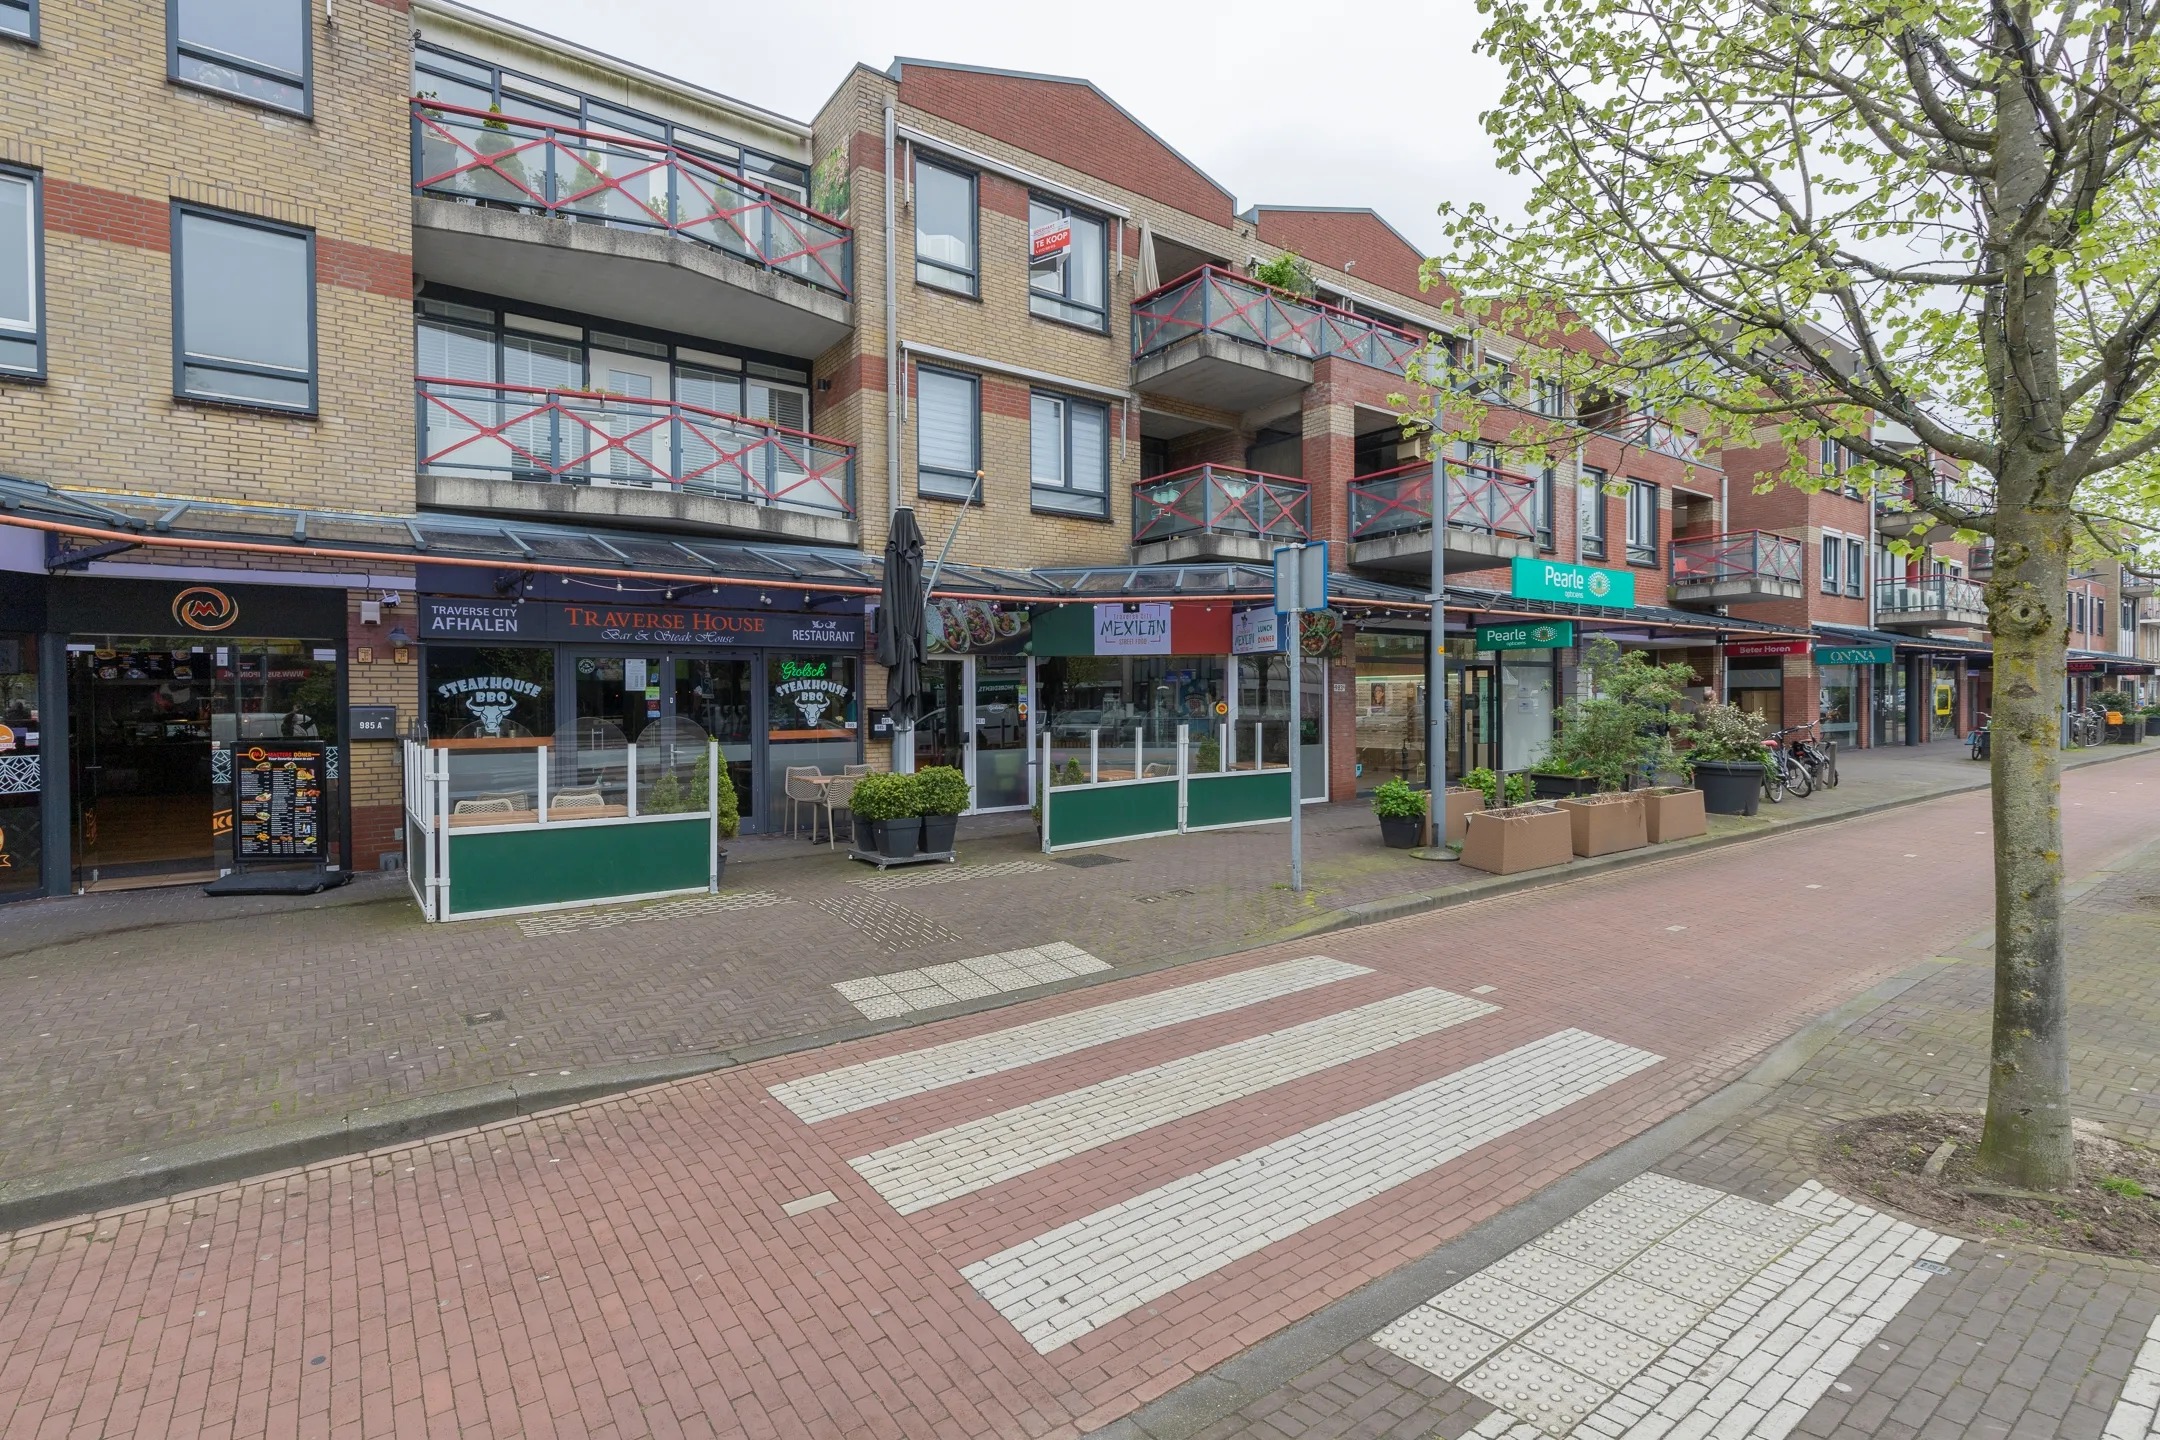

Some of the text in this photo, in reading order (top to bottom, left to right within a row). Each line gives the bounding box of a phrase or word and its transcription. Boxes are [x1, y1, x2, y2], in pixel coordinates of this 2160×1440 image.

[1035, 231, 1068, 248] TE KOOP
[1545, 565, 1584, 589] Pearle
[1564, 590, 1584, 599] opticiens
[431, 605, 517, 617] TRAVERSE CITY
[431, 616, 518, 632] AFHALEN
[565, 607, 765, 632] TRAVERSE HOUSE
[1100, 619, 1166, 637] MEXICAN
[1257, 624, 1273, 633] LUNCH
[1486, 628, 1527, 642] Pearle
[601, 628, 735, 643] Bar & Steak House
[792, 629, 855, 642] RESTAURANT
[1257, 635, 1275, 644] DINNER
[1739, 645, 1791, 654] Beter Horen
[781, 661, 827, 680] Grolsch
[438, 676, 543, 699] STEAKHOUSE
[775, 679, 849, 698] STEAKHOUSE
[475, 691, 508, 704] BBQ
[801, 691, 824, 703] BBQ
[359, 721, 383, 730] 985 A
